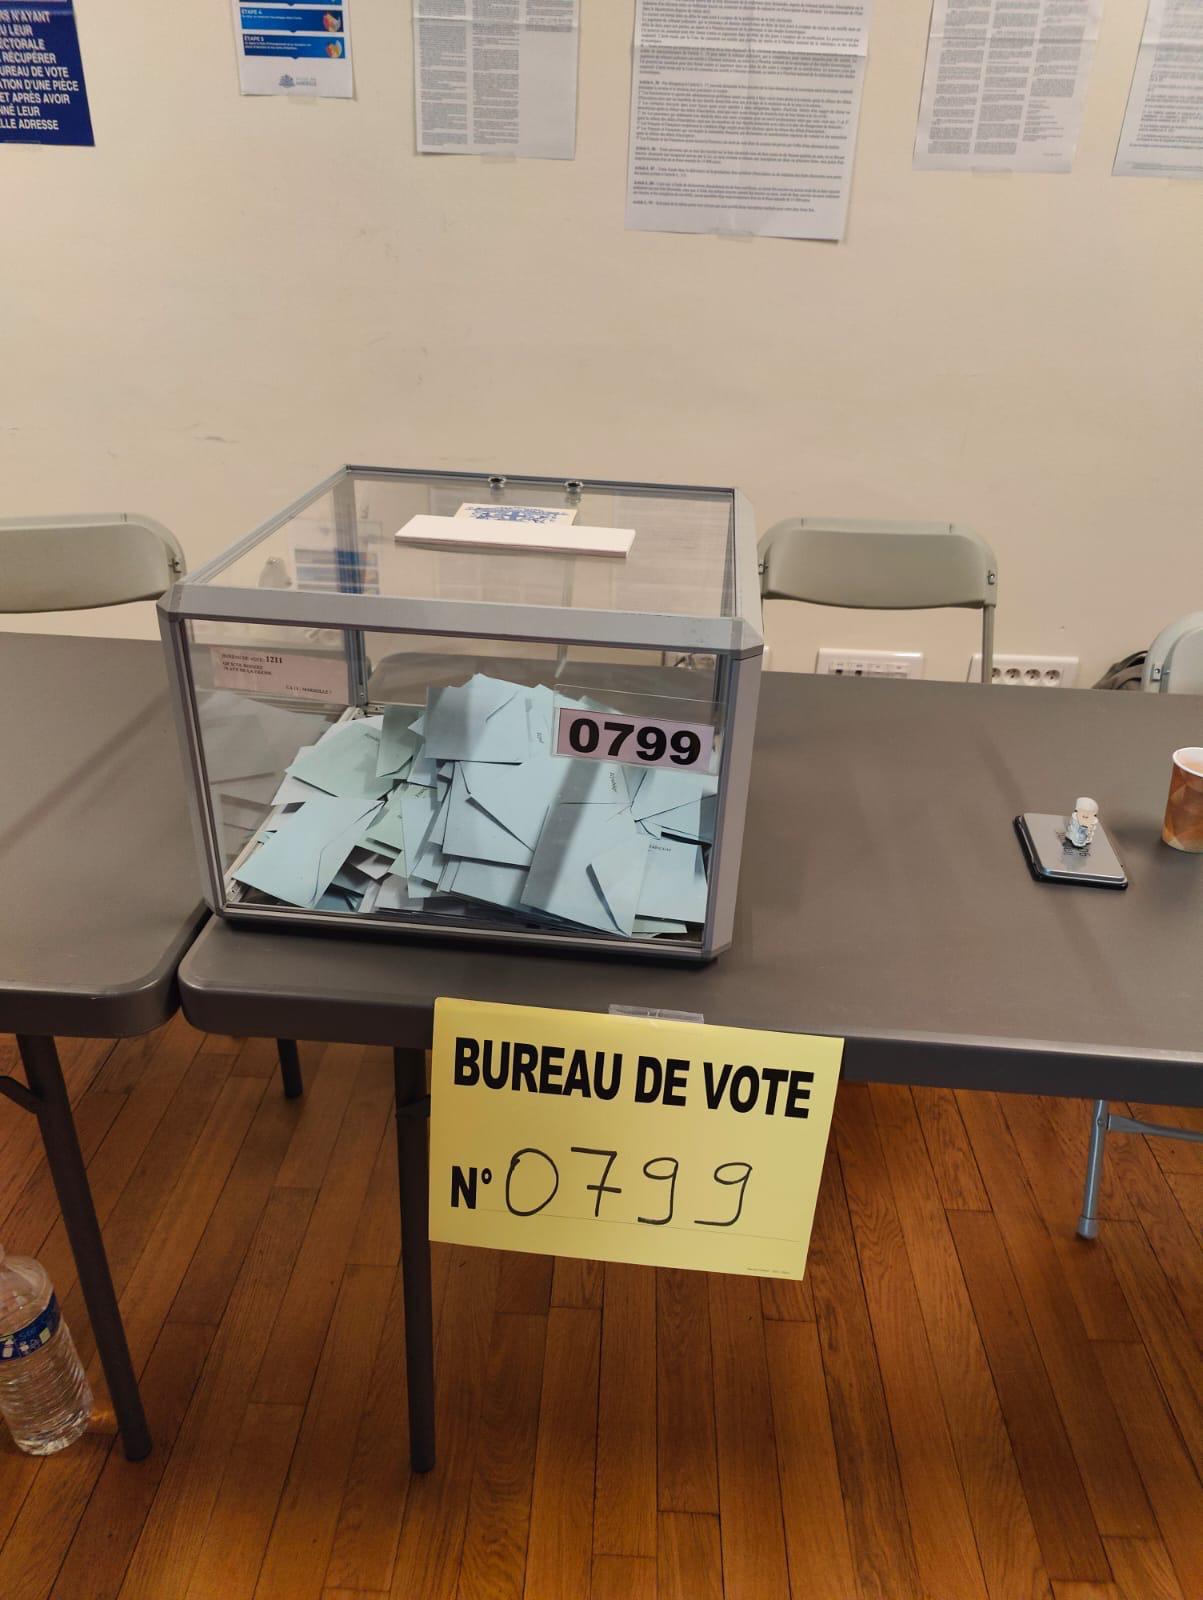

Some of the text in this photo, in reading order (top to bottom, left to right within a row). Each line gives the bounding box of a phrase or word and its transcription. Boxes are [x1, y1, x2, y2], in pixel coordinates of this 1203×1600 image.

[10, 10, 50, 23] N'AYANT
[8, 24, 33, 37] LEUR
[31, 66, 43, 77] DE
[45, 67, 69, 78] VOTE
[24, 80, 51, 90] D'UNE
[53, 78, 79, 91] PIÈCE
[0, 92, 9, 102] ET
[43, 93, 70, 104] AVOIR
[17, 106, 40, 116] LEUR
[0, 118, 59, 130] LLE ADRESSE
[266, 656, 283, 664] 1211
[569, 718, 701, 765] 0799
[454, 1036, 815, 1119] BUREAU DE VOTE
[505, 1147, 753, 1227] 0799
